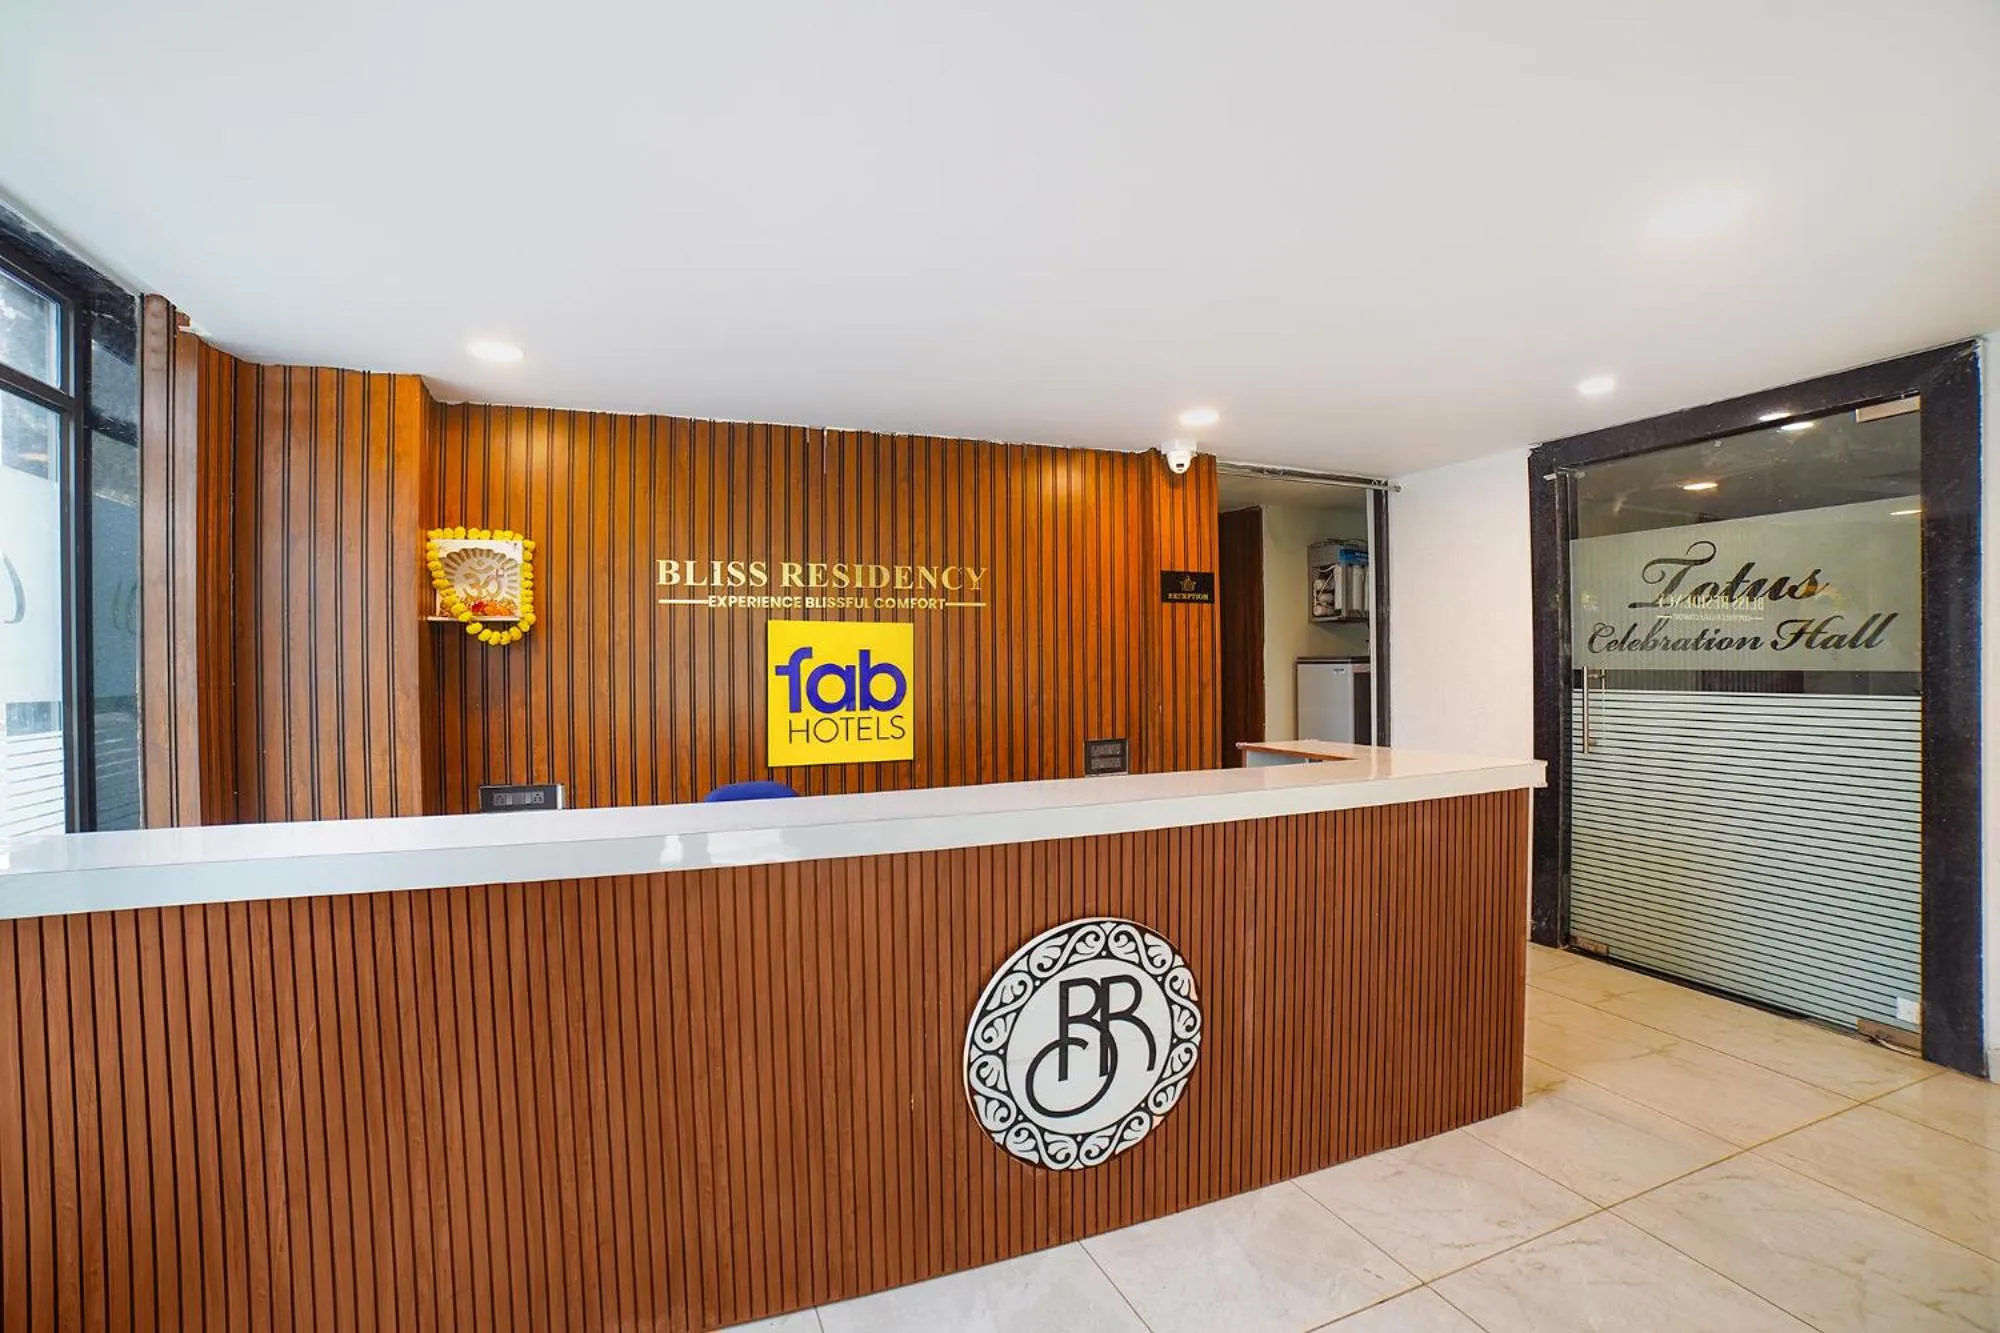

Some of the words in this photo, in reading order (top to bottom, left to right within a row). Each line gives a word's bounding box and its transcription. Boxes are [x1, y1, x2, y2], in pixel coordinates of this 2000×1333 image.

[656, 559, 768, 587] BLISS
[780, 561, 987, 591] RESIDENCY
[708, 595, 802, 609] EXPERIENCE
[805, 596, 872, 609] BLISSFUL
[874, 597, 946, 610] COMFORT
[1587, 617, 1764, 654] Celebration
[1770, 612, 1899, 651] Hall
[774, 646, 908, 714] fab
[789, 715, 906, 744] HOTELS
